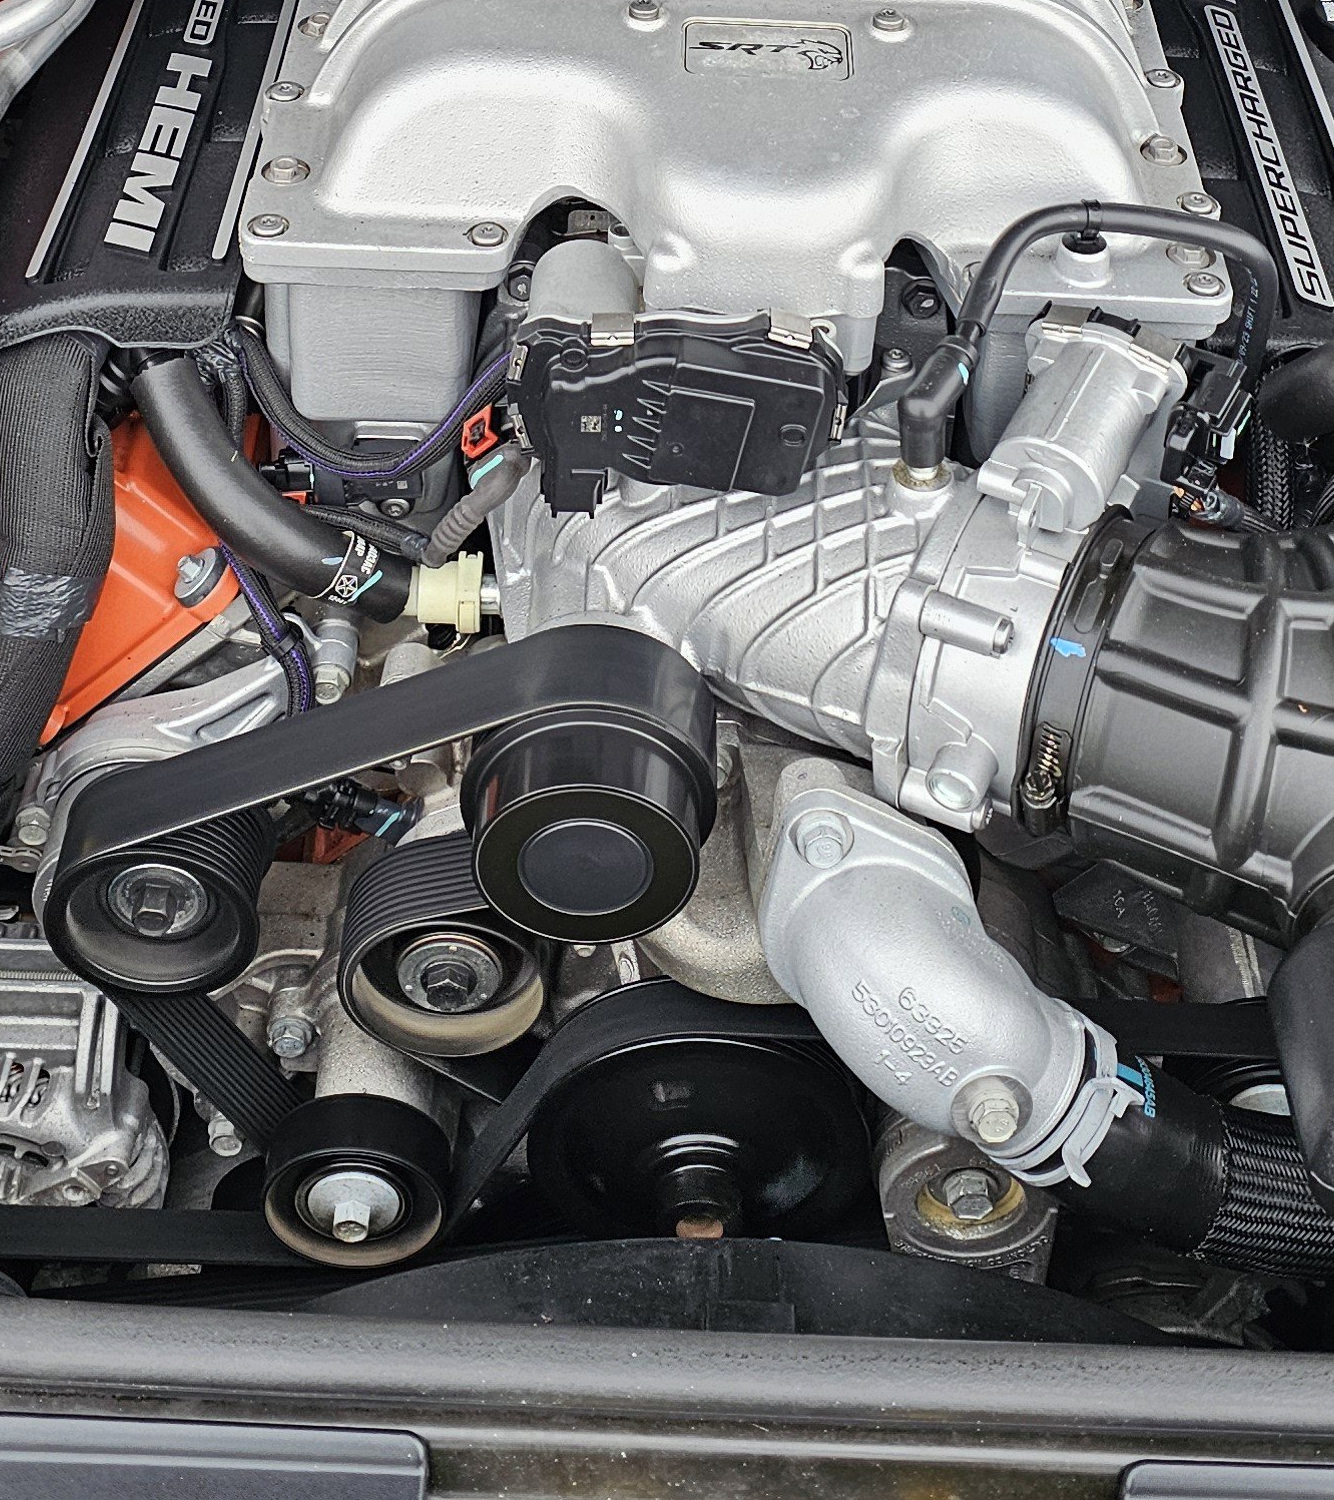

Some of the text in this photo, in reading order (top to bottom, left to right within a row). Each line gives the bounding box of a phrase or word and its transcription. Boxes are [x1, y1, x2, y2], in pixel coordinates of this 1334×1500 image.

[688, 40, 800, 56] SRT
[103, 52, 213, 253] HEMI
[1209, 7, 1330, 307] SUPERCHARGED
[851, 980, 959, 1087] 53010923AB
[898, 986, 968, 1055] 63325
[873, 1049, 913, 1086] 1-4
